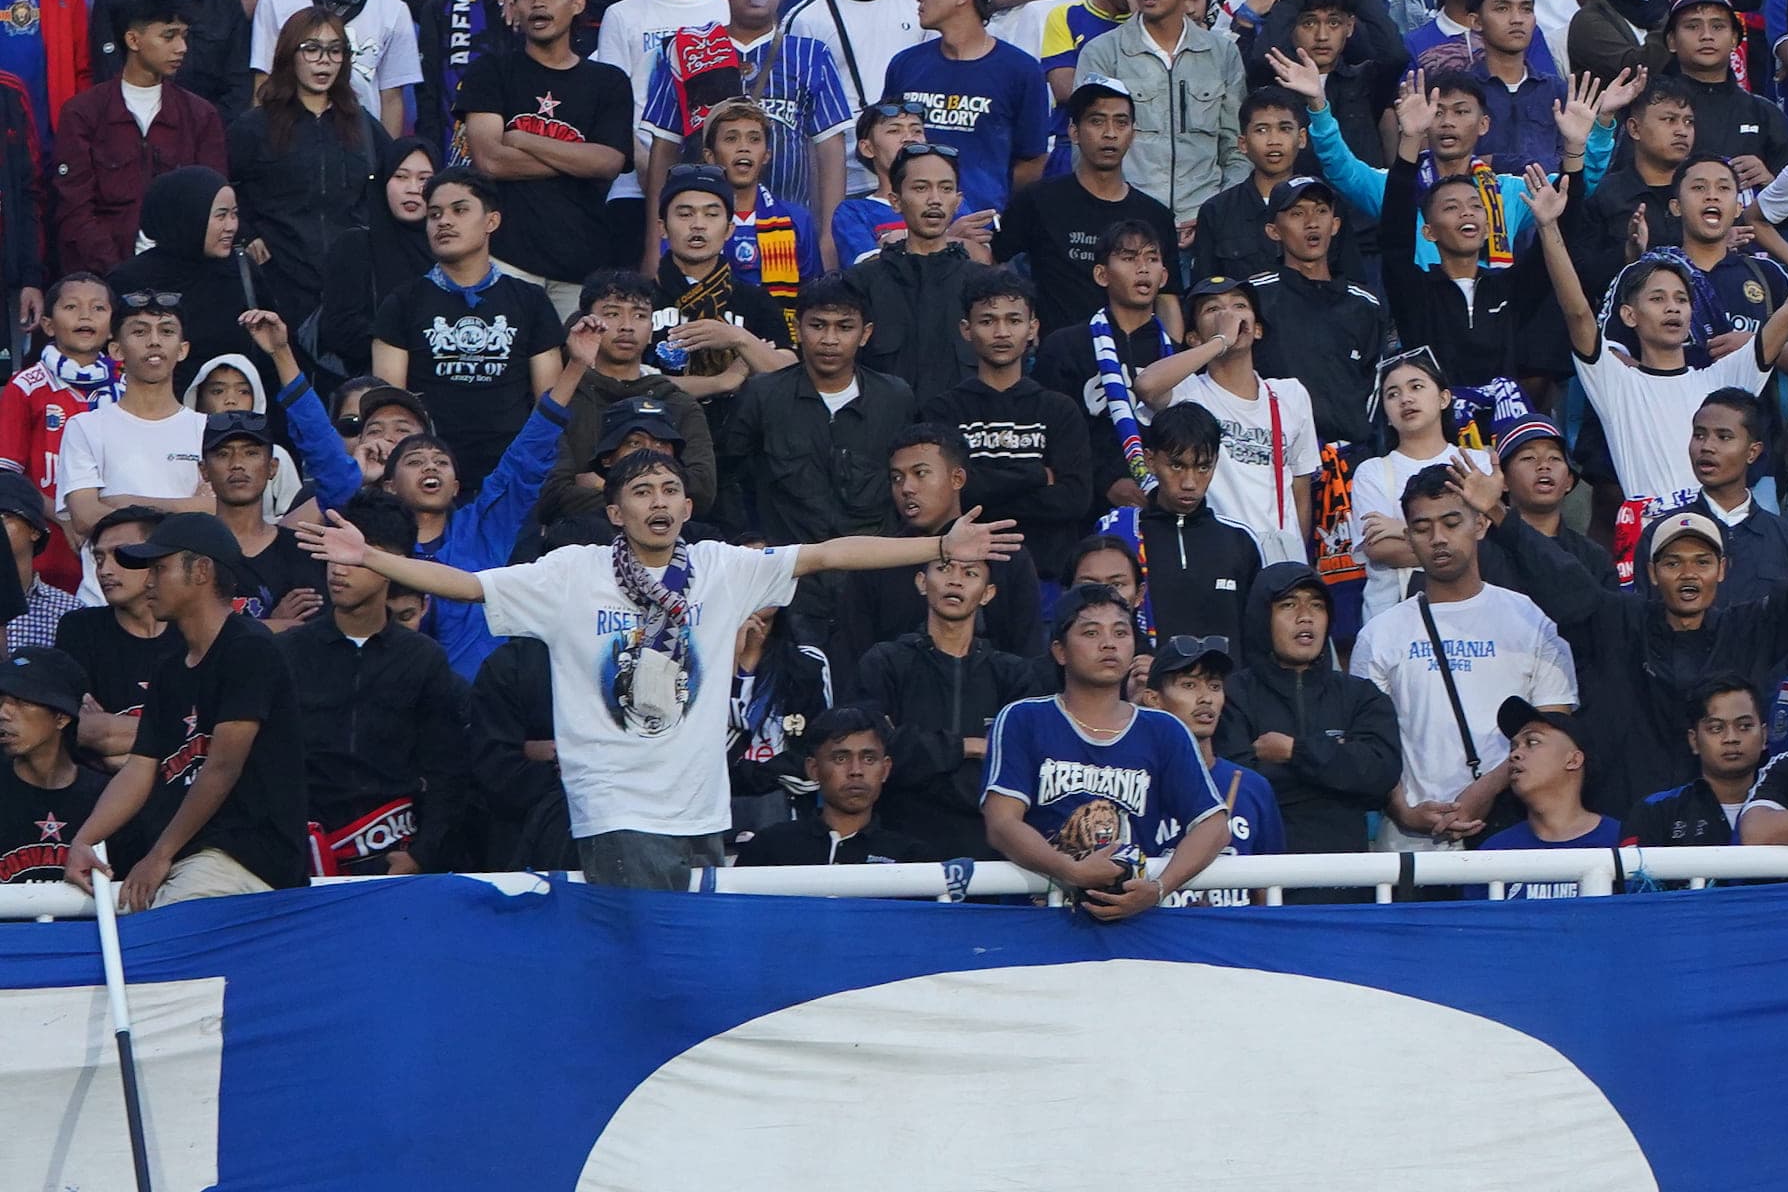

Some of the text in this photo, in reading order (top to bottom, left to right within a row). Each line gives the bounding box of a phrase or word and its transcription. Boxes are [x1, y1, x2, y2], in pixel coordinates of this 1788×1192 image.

[929, 110, 980, 128] GLORY
[435, 361, 508, 376] CITY OF
[1408, 640, 1496, 659] ARMANIA
[1039, 758, 1152, 818] AREMANIA
[1526, 882, 1580, 900] MALANG
